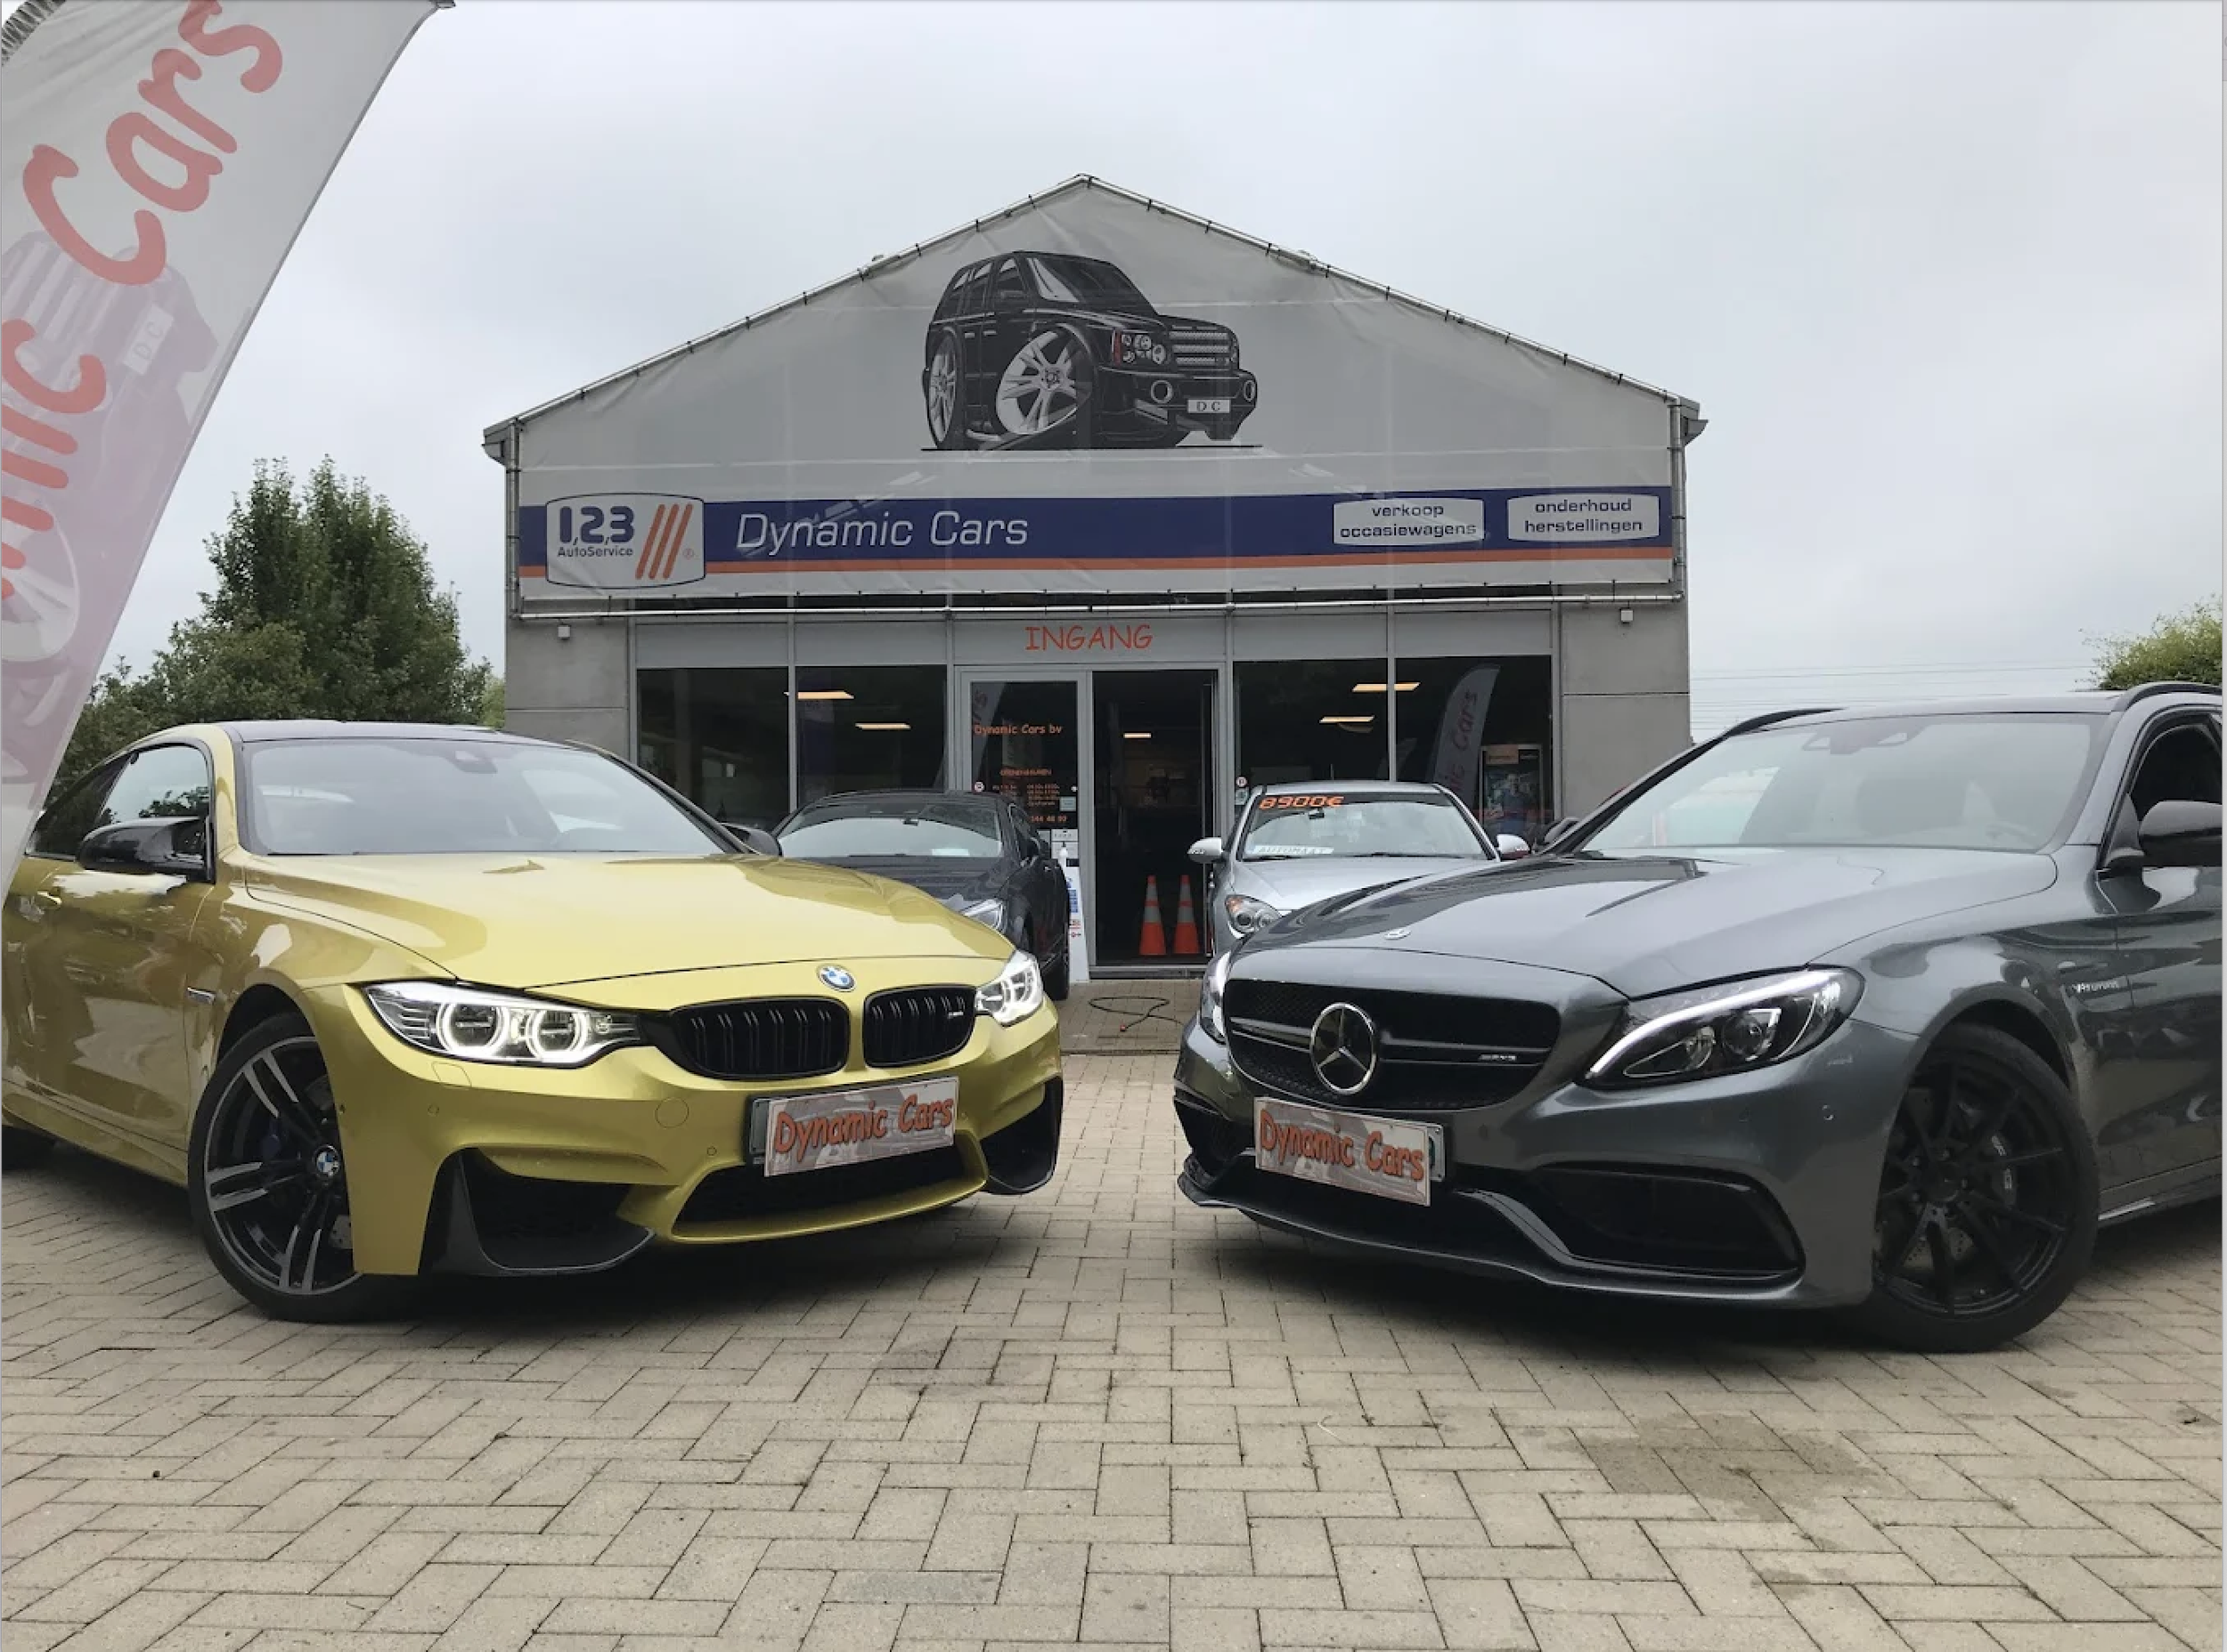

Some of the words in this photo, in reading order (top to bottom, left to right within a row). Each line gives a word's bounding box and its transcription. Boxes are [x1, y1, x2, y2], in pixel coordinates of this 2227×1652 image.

[22, 0, 283, 286] Cars
[1371, 503, 1444, 518] verkoop
[1535, 499, 1632, 513] onderhoud
[737, 512, 913, 556] Dynamic
[929, 510, 1028, 545] Cars
[1340, 523, 1477, 538] occasiewagens
[1524, 518, 1643, 534] herstellingen
[557, 546, 633, 557] AutoService
[1024, 624, 1153, 651] INGANG
[974, 723, 1017, 736] Dynamic
[1022, 723, 1046, 734] Cars
[773, 1100, 888, 1163] Dynamic
[898, 1093, 954, 1133] Cars
[1260, 1109, 1354, 1168] Dynamic
[1365, 1131, 1424, 1182] Cars
